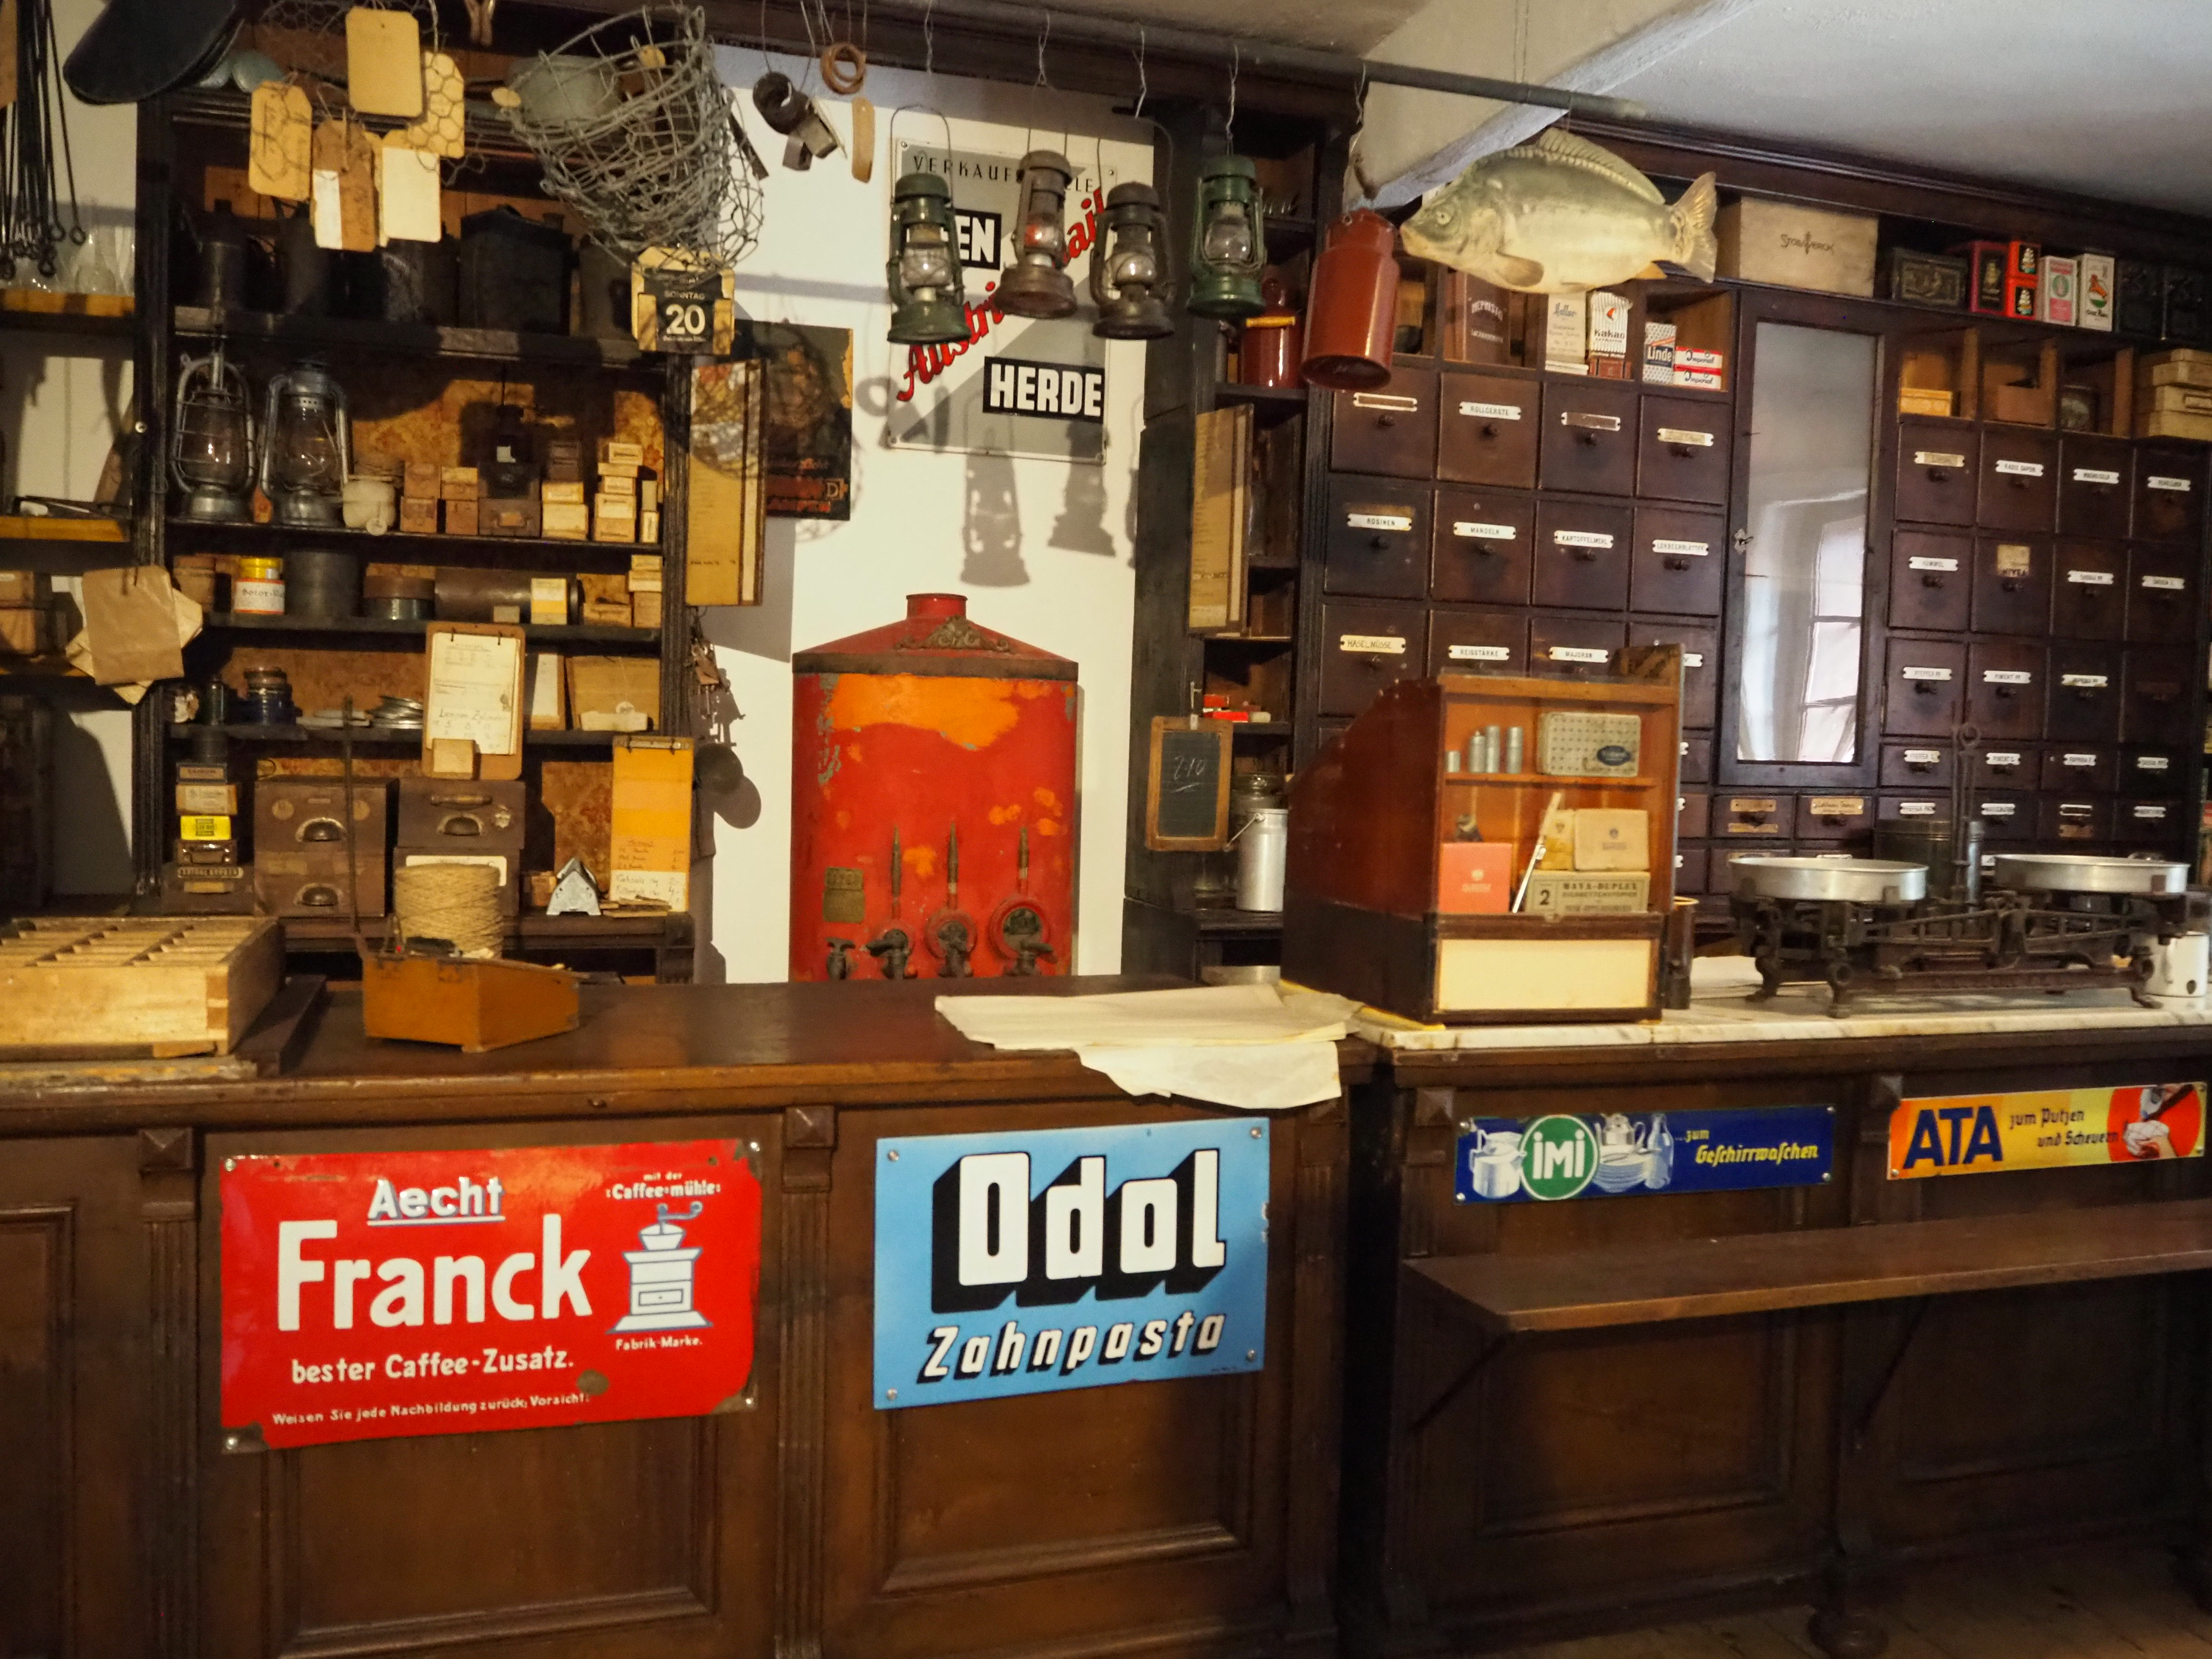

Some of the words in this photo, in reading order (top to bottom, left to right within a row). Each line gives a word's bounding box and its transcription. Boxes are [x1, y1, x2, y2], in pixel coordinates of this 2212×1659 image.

[666, 304, 705, 335] 20
[1594, 328, 1625, 339] Kakao
[1647, 345, 1672, 362] Linde
[990, 363, 1102, 417] HERDE
[1470, 405, 1509, 416] ROLLGERSTE
[1367, 517, 1395, 527] ROSINEN
[1470, 527, 1500, 536] MANDELN
[1562, 534, 1608, 545] KARTOFFELMEHL
[1460, 648, 1499, 658] REISSTÄRKE
[1565, 650, 1593, 659] MAJORAN
[1539, 889, 1550, 905] 2
[2009, 1114, 2037, 1131] zum
[2041, 1108, 2085, 1129] Putzen
[1903, 1106, 2004, 1169] ATA
[2037, 1132, 2062, 1148] und
[2065, 1130, 2118, 1146] Scheuern
[368, 1176, 505, 1221] Aecht
[958, 1148, 1227, 1286] Odol
[277, 1213, 593, 1332] Franck
[917, 1310, 1226, 1384] Zahnpasta
[291, 1358, 376, 1384] bester
[385, 1345, 575, 1379] Caffee-Zusatz.
[273, 1413, 324, 1425] Weisen
[329, 1409, 352, 1422] Sie
[356, 1407, 386, 1422] jede
[390, 1397, 477, 1417] Nachbildung
